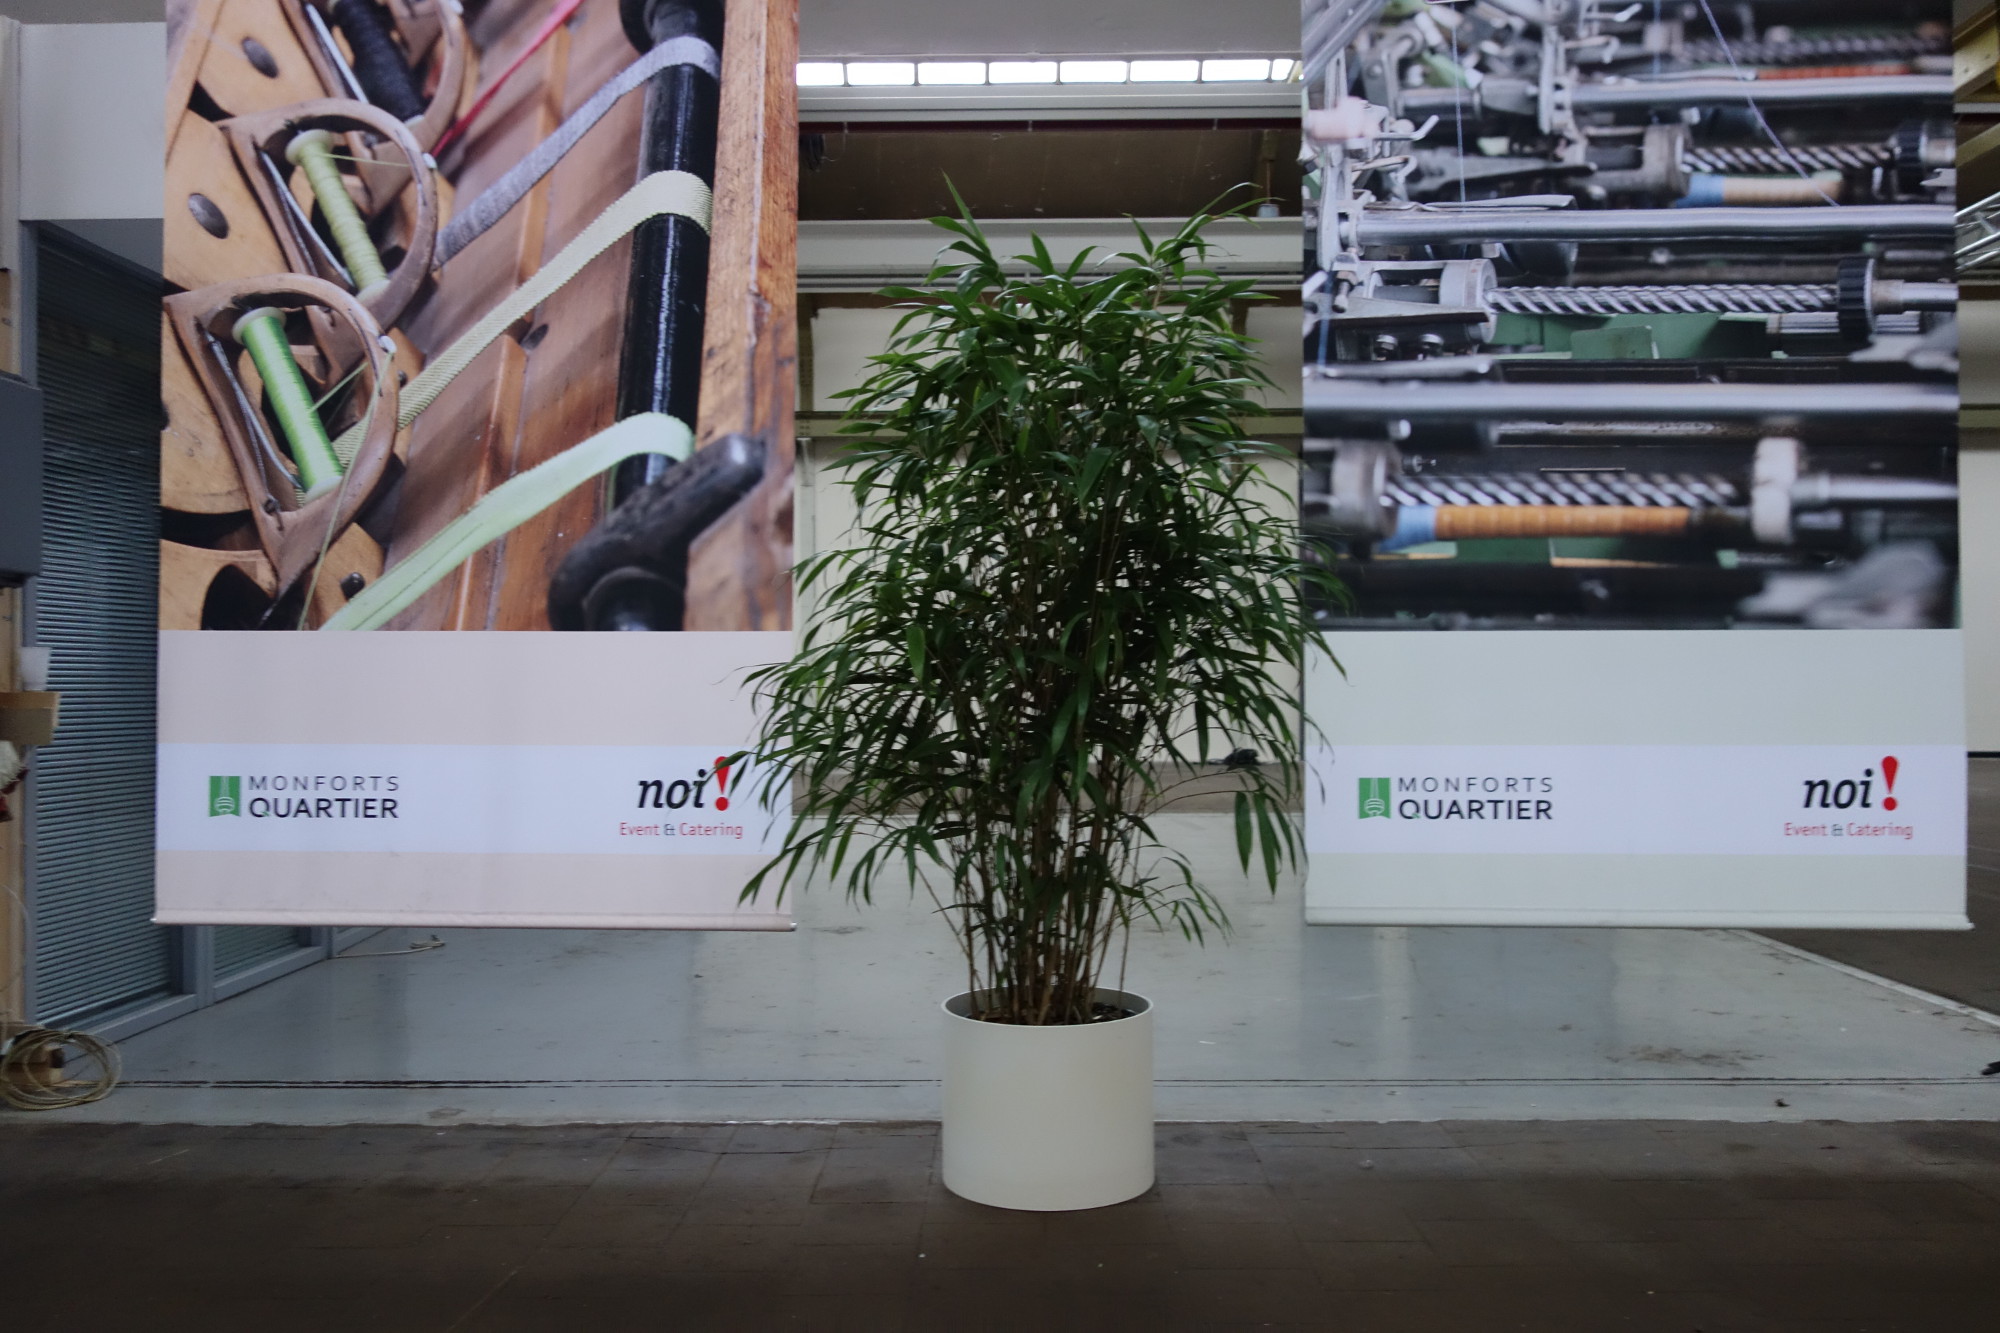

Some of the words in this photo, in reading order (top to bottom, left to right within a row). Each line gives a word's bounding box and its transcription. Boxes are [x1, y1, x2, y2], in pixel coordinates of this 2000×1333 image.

[248, 775, 400, 792] MONFORTS
[1398, 776, 1554, 793] MONFORTS
[1803, 756, 1898, 812] noi!
[249, 797, 399, 819] QUARTIER
[1398, 798, 1553, 820] QUARTIER
[619, 822, 660, 837] Event
[678, 822, 743, 840] Catering
[1784, 822, 1828, 837] Event
[1846, 822, 1914, 840] Catering
